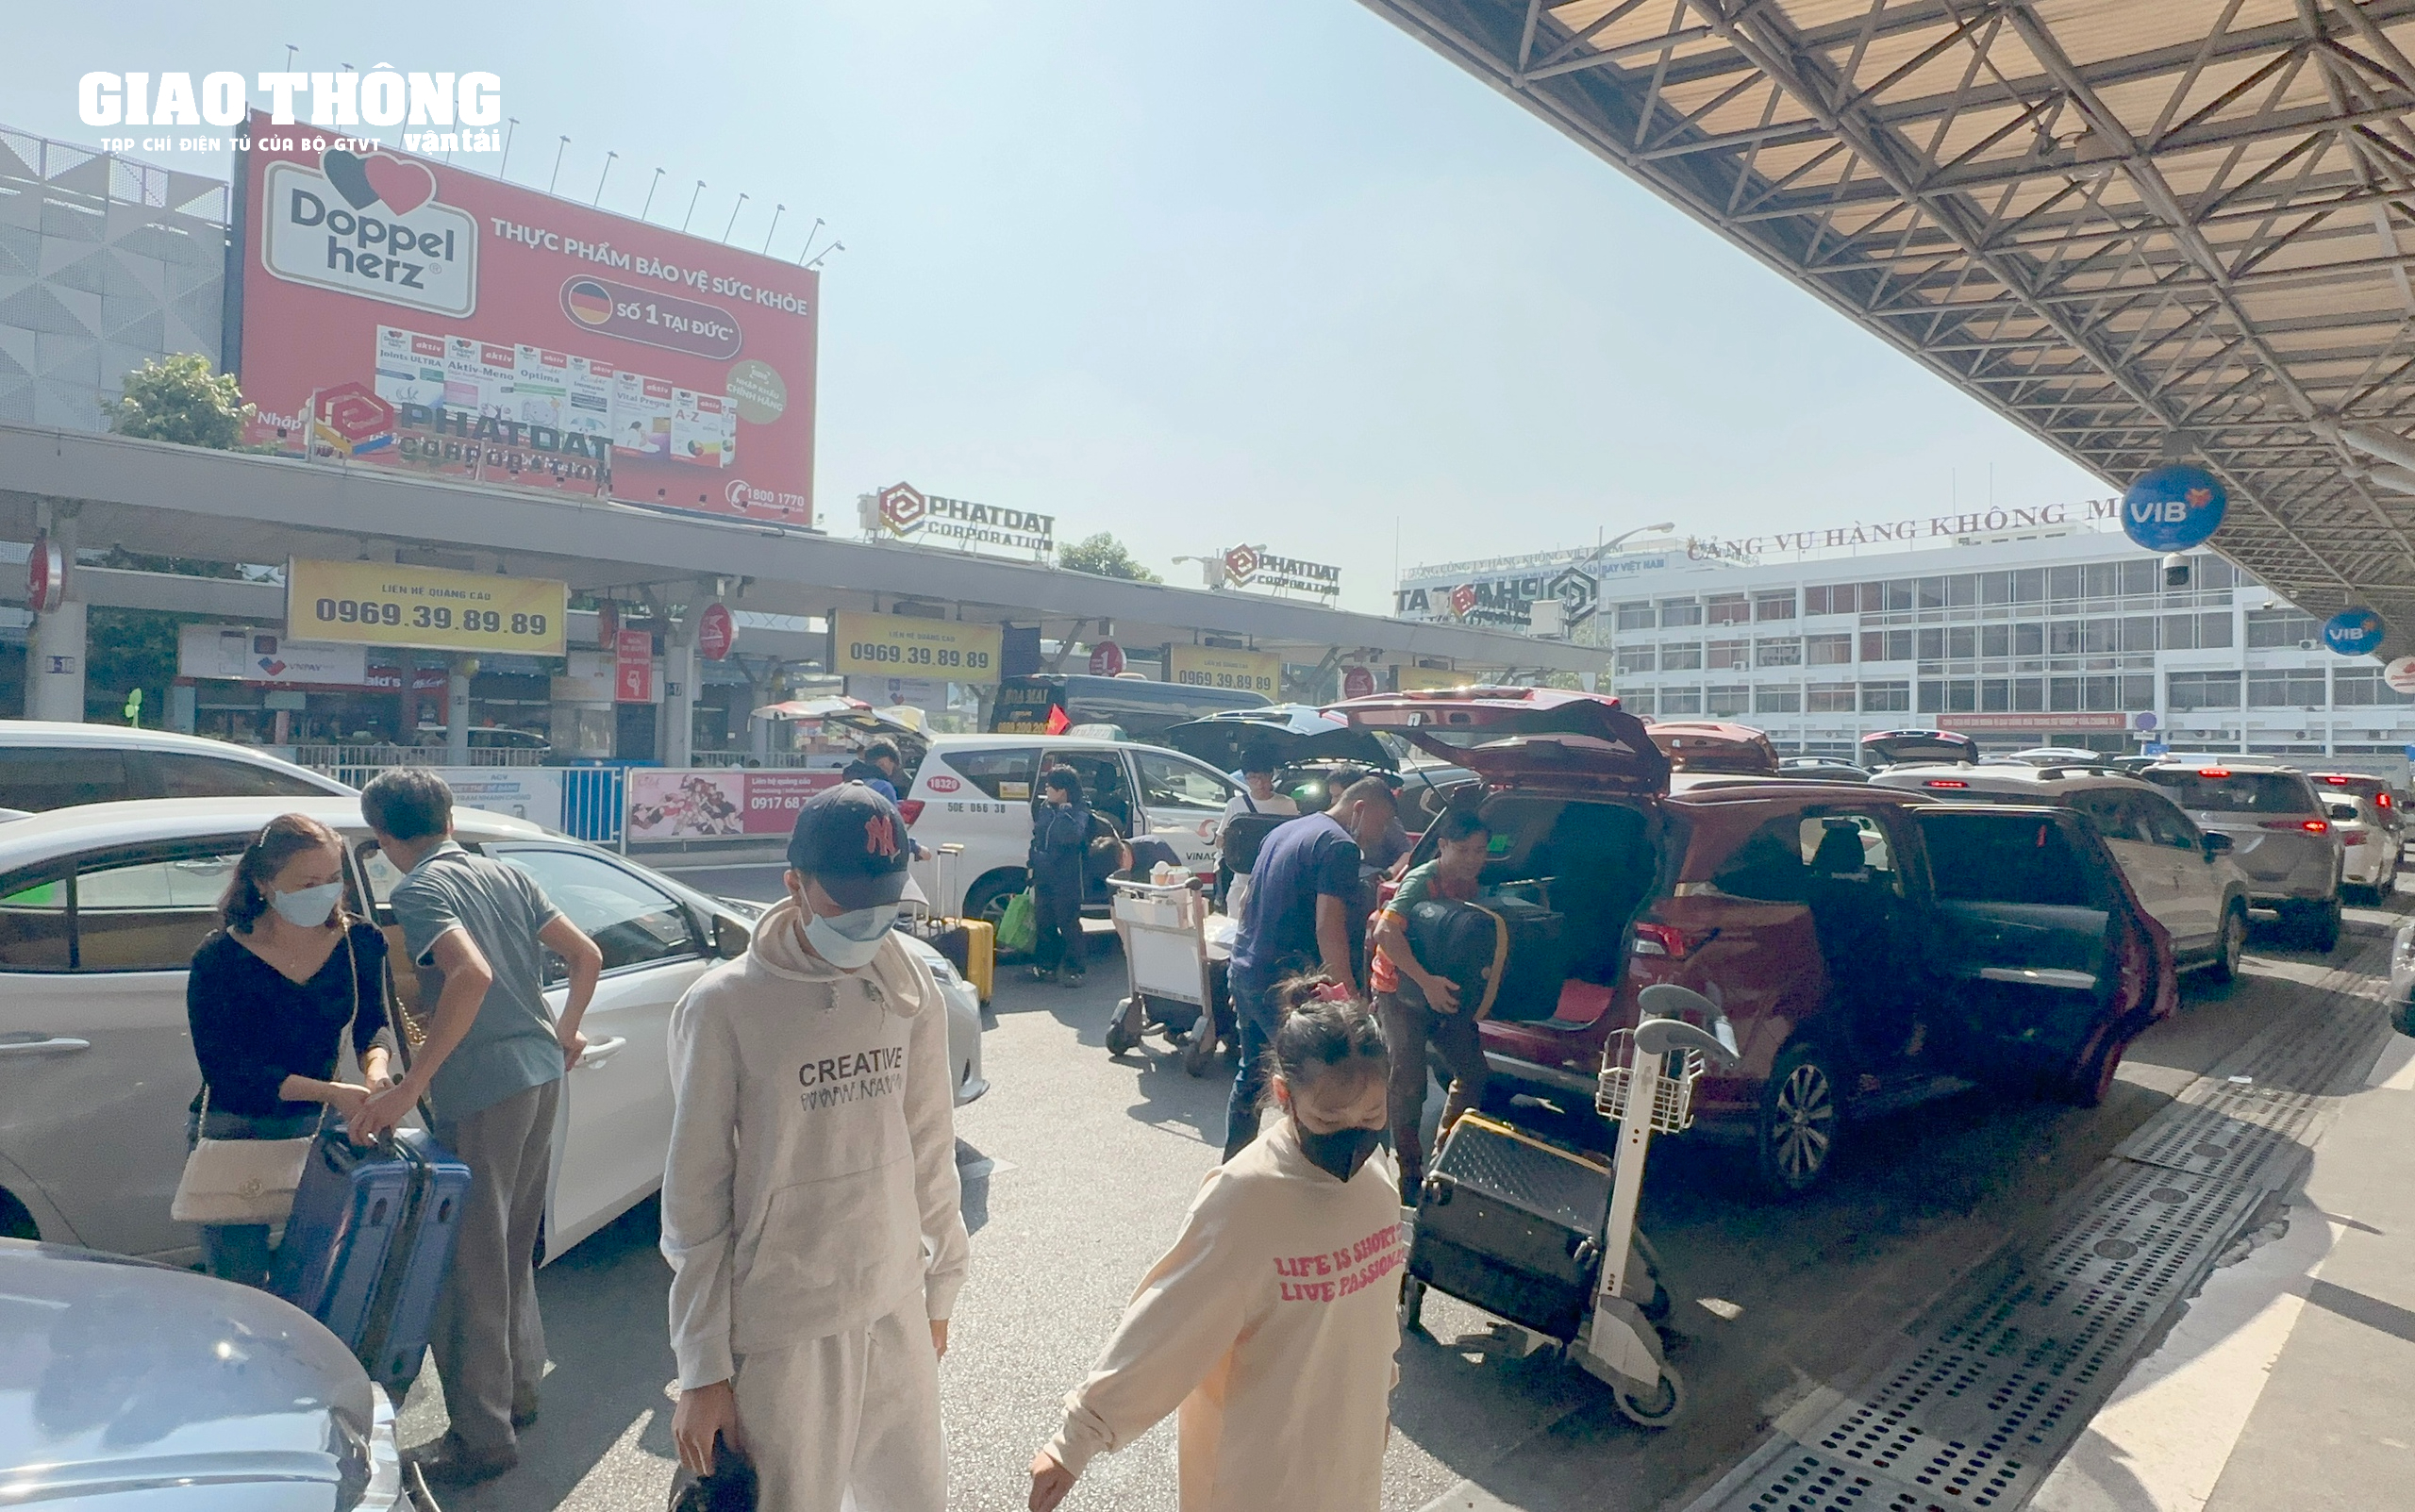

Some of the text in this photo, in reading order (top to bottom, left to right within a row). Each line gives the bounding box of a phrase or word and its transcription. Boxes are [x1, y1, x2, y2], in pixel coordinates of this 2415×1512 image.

[291, 188, 454, 262] Doppel
[327, 235, 425, 290] herz
[491, 217, 808, 316] THỰC PHẨM BẢO VỆ SỨC KHỎE
[616, 301, 641, 321] SỐ
[644, 304, 658, 325] 1
[662, 312, 688, 333] TẠI
[415, 341, 442, 353] aktiv
[485, 351, 513, 363] aktiv
[410, 355, 441, 368] ULTRA
[447, 360, 514, 381] Aktiv-Meno
[521, 369, 559, 384] Optima
[617, 391, 638, 402] Vital
[726, 383, 784, 412] CHÍNH HÀNG
[675, 408, 700, 423] A-Z
[401, 401, 614, 462] PHATDAT
[747, 488, 805, 507] 1800 1770
[929, 495, 1056, 534] PHATDAT
[2131, 502, 2187, 523] VIB
[928, 521, 1054, 551] CORPORATION
[1688, 535, 1763, 561] CẢNG
[1774, 532, 1813, 555] VỤ
[1825, 521, 1916, 548] HÀNG
[1929, 506, 2066, 536] KHÔNG
[1258, 553, 1341, 581] PHATDAT
[1441, 560, 1471, 574] CÔNG
[1488, 555, 1520, 569] HÀNG
[1522, 550, 1563, 565] KHÔNG
[1622, 561, 1641, 573] VIỆT
[1642, 559, 1664, 570] NAM
[1257, 574, 1341, 596] CORPORATION
[316, 598, 547, 636] 0969.39.89.89
[2329, 628, 2364, 640] VIB
[850, 641, 990, 669] 0969.39.89.89
[290, 663, 323, 672] VNPAY
[751, 796, 782, 810] 0917
[784, 796, 800, 809] 68
[947, 802, 964, 812] 50E
[799, 1047, 903, 1087] CREATIVE
[1274, 1224, 1396, 1277] LIFE IS SHORT
[1279, 1248, 1404, 1302] LIVE PASSION
